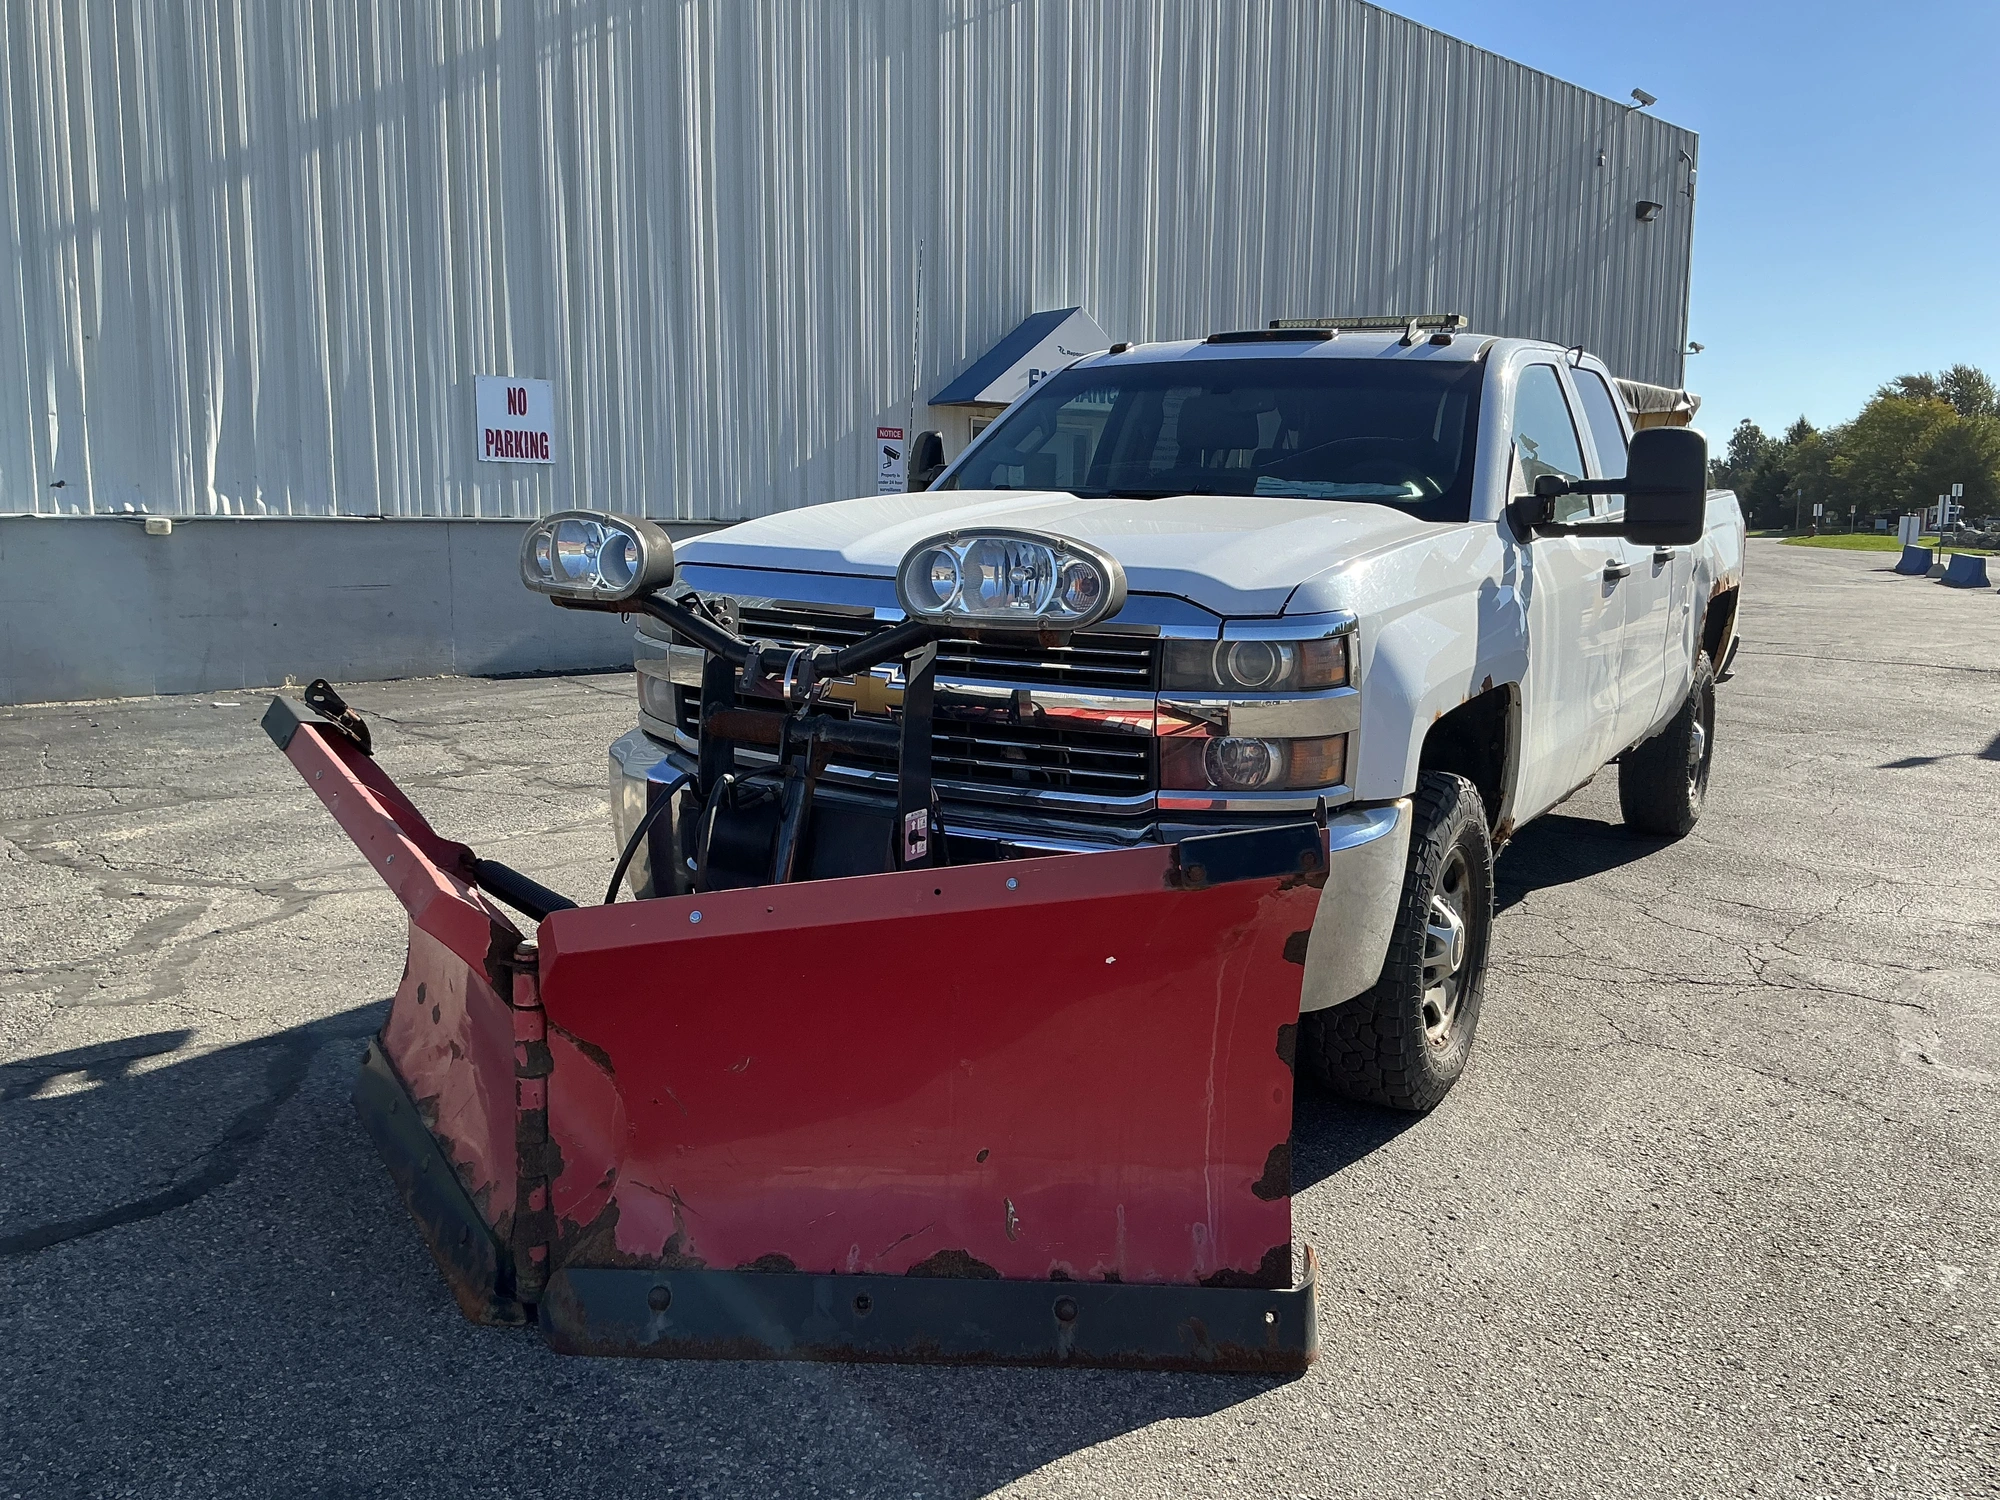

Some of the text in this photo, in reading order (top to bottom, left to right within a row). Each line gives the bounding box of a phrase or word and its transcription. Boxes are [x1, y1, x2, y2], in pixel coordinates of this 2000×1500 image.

[507, 387, 527, 416] NO
[485, 428, 549, 459] PARKING
[879, 429, 902, 438] NOTICE
